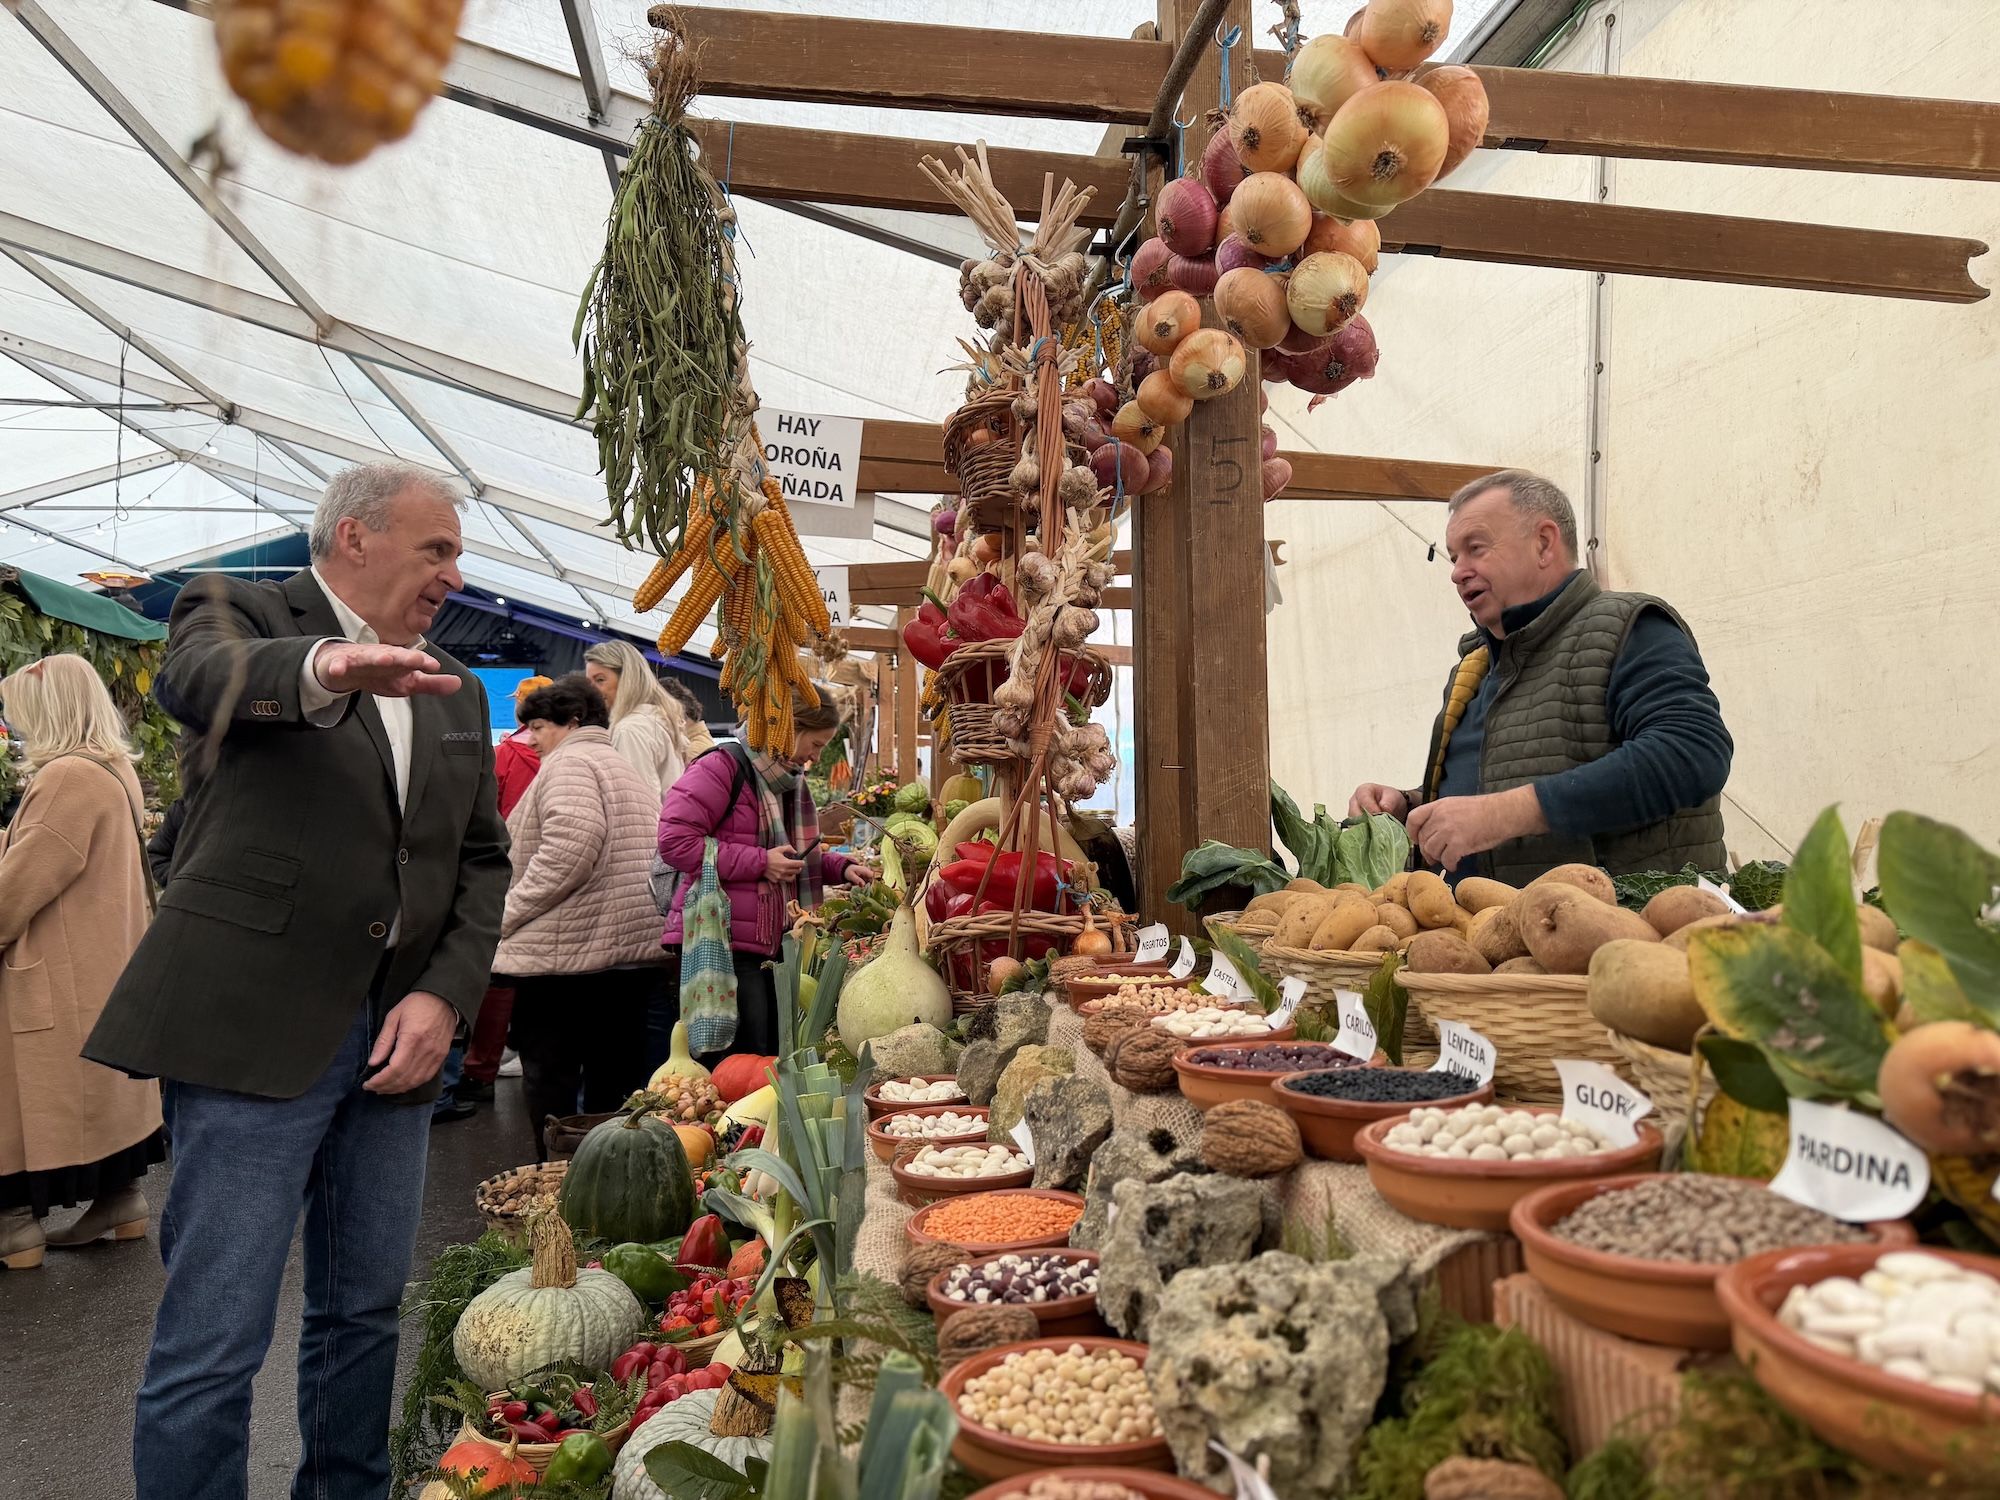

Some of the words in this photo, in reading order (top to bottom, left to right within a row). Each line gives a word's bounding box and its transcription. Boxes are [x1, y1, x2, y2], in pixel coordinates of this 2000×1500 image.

[777, 414, 821, 437] HAY
[764, 443, 841, 472] OROÑA
[774, 472, 844, 502] ÑADA
[1141, 937, 1168, 951] NEGRITOS
[1447, 1028, 1486, 1065] LENTEJA
[1797, 1133, 1912, 1192] PARDINA
